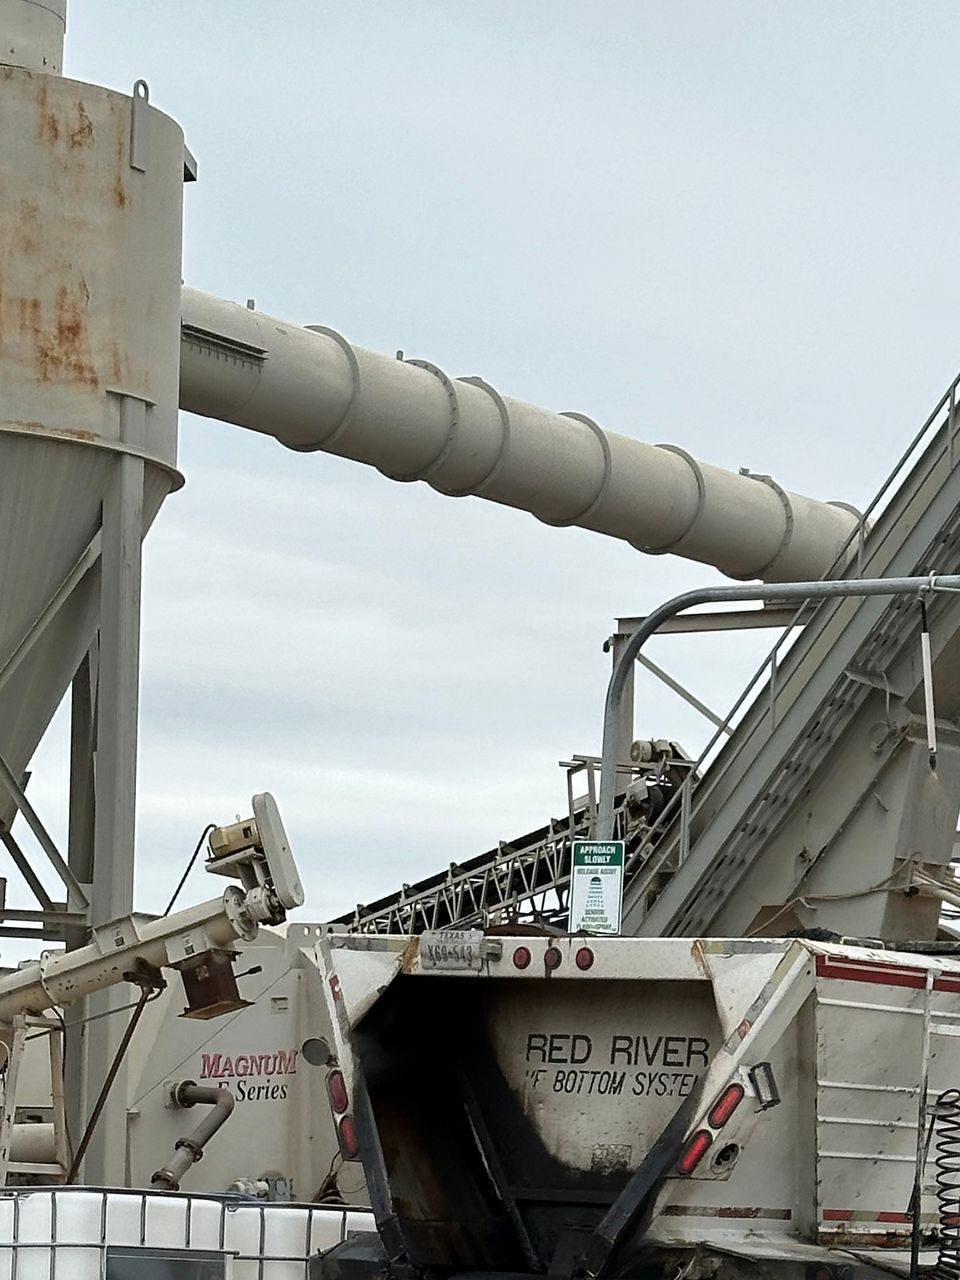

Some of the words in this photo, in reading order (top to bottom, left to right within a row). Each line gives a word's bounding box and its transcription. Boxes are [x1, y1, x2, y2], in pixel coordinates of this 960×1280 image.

[580, 845, 616, 855] APPROACH
[584, 855, 612, 864] SLOWLY
[440, 931, 466, 940] TEXAS
[526, 1033, 593, 1065] RED
[610, 1035, 711, 1068] RIVER
[200, 1049, 299, 1079] MAGNUM
[235, 1078, 288, 1102] Series
[553, 1070, 627, 1096] BOTTOM
[632, 1072, 699, 1097] SYSTE
